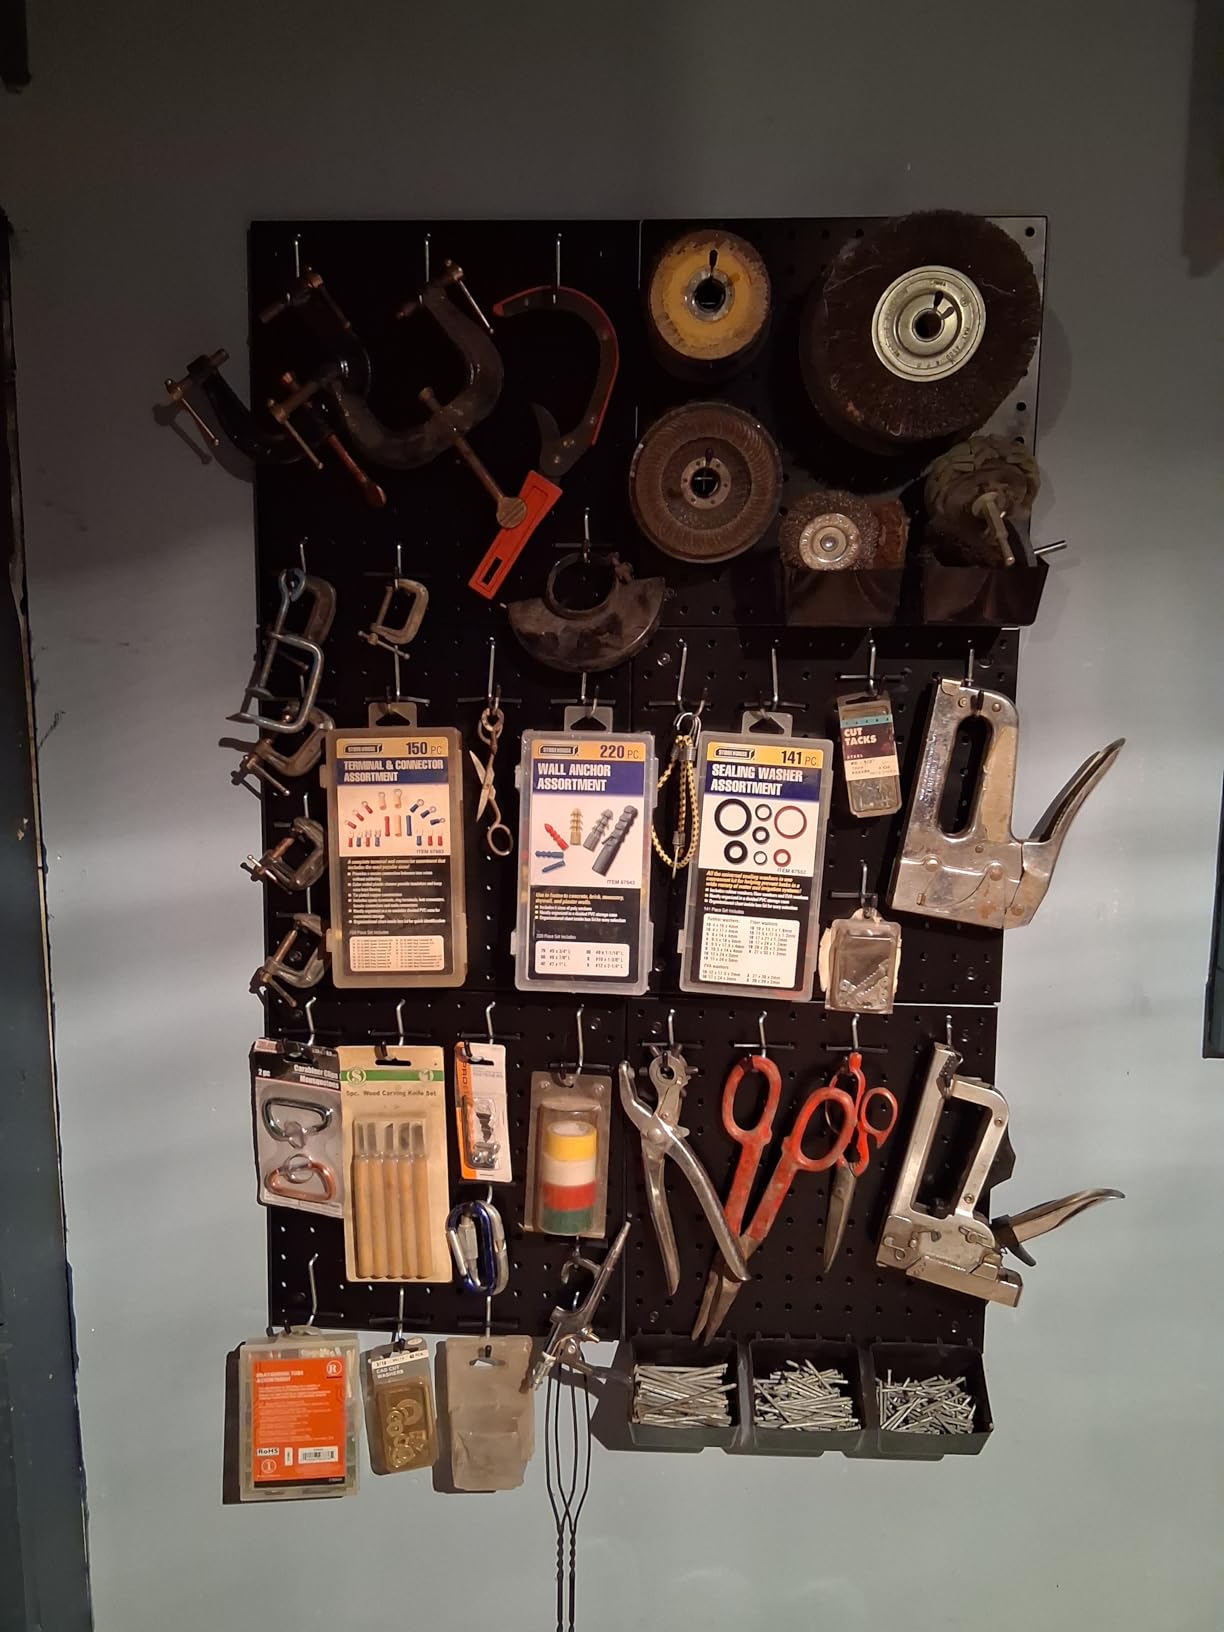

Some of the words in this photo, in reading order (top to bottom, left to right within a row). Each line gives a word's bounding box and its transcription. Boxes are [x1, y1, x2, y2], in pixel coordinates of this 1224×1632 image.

[844, 727, 863, 737] CUT
[844, 734, 877, 746] TACKS
[406, 741, 428, 755] 150
[430, 745, 443, 754] PC
[599, 744, 625, 759] 220
[627, 749, 639, 760] PC
[343, 760, 384, 770] TERMINAL
[386, 761, 394, 770] &
[395, 759, 444, 770] CONNECTOR
[781, 750, 802, 765] 141
[804, 755, 817, 767] PC
[343, 771, 399, 782] ASSORTMENT
[537, 762, 567, 776] WALL
[569, 763, 611, 777] ANCHOR
[711, 763, 755, 779] SEALING
[757, 767, 803, 783] WASHER
[536, 777, 607, 792] ASSORTMENT
[710, 778, 783, 796] ASSORTMENT
[257, 1068, 263, 1076] 2
